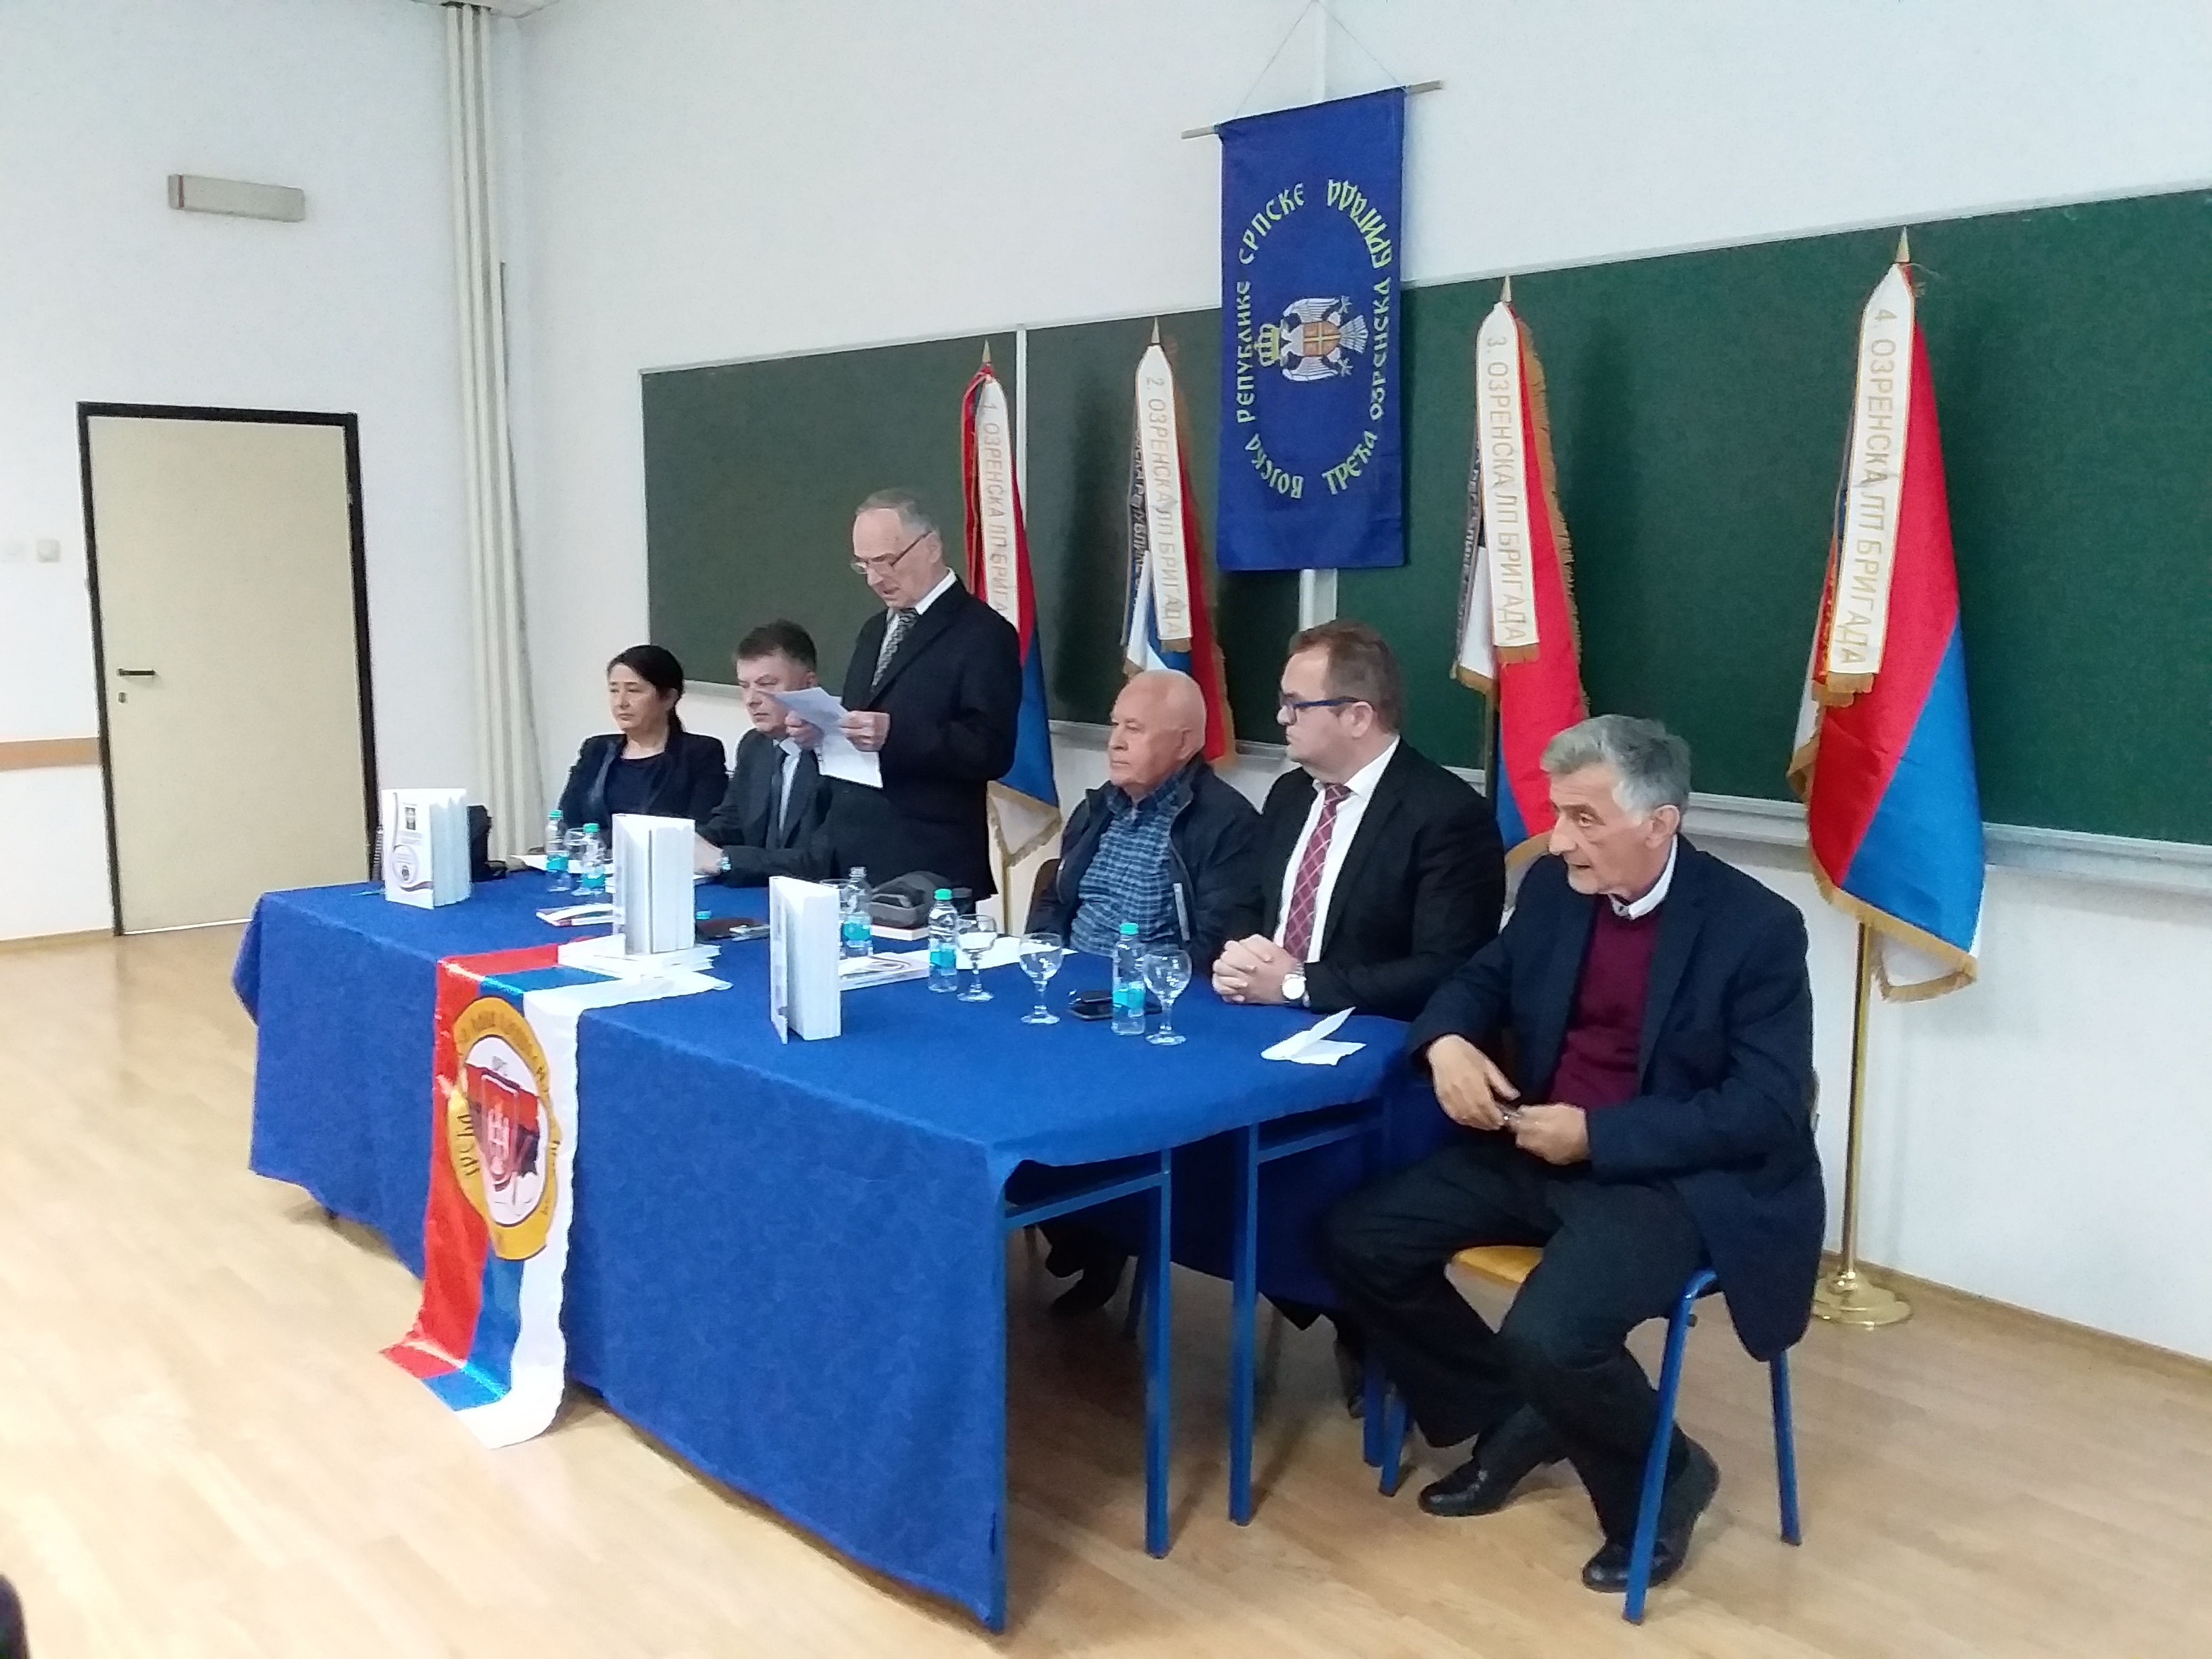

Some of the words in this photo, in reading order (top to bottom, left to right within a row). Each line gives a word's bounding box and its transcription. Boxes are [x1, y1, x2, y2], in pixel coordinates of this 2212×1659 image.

[1239, 182, 1304, 265] СРПСКЕ
[1327, 179, 1393, 270] БРИГАДА
[1237, 281, 1256, 424] РЕПУБЛИКЕ
[1370, 277, 1392, 421] ОЗРЕНСКА
[1148, 398, 1172, 501] ОЗРЕНСКА
[1488, 361, 1515, 487] ОЗРЕНСКА
[1862, 339, 1896, 485] ОЗРЕНСКА
[985, 423, 1004, 517] ОЗРЕНСКА
[1244, 433, 1304, 499] ВОЈСКА
[1322, 430, 1378, 495] ТРЕЋА
[1496, 493, 1518, 523] ЛП
[989, 525, 1008, 547] ЛП
[1155, 508, 1173, 535] ЛП
[1858, 492, 1885, 531] ЛП
[990, 553, 1008, 611] БРИГА
[1160, 543, 1182, 634] БРИГАДА
[1498, 533, 1526, 640] БРИГАДА
[1837, 539, 1881, 664] БРИГАДА
